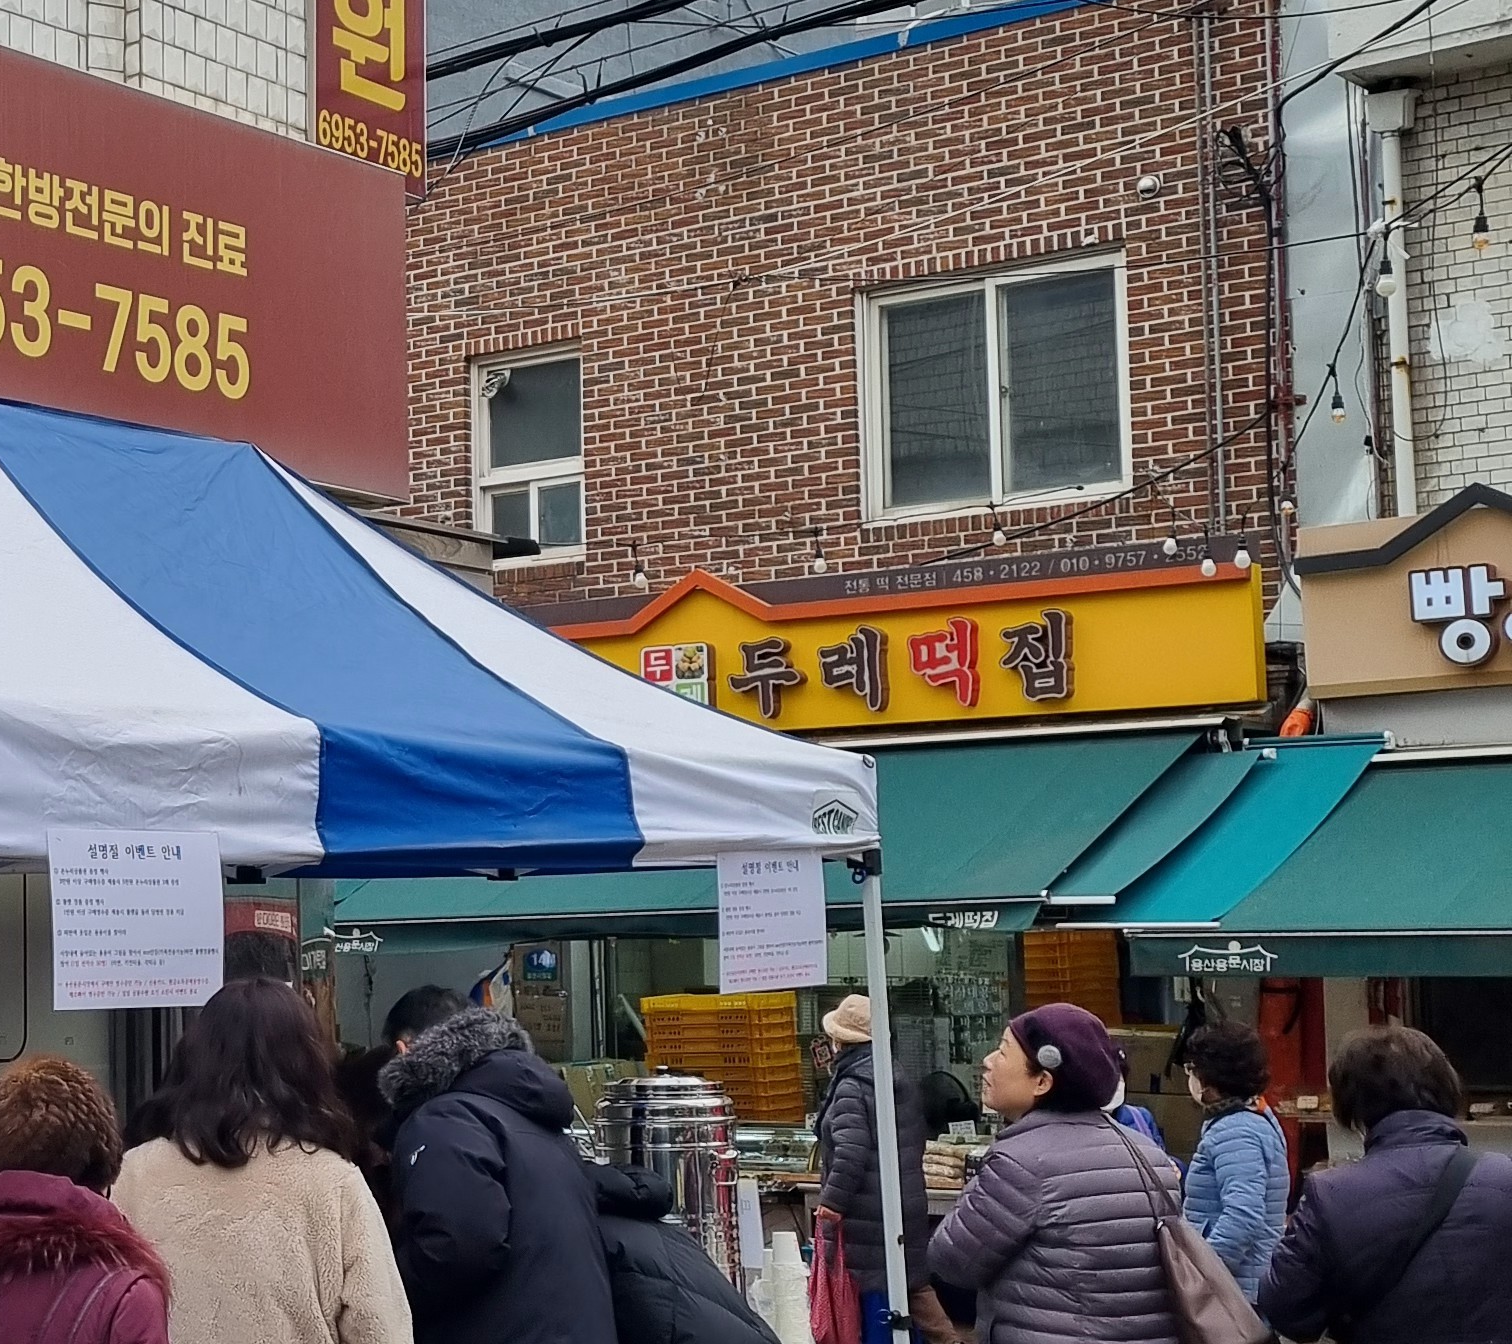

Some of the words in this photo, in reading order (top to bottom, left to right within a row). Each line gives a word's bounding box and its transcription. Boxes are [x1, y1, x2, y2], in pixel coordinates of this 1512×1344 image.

[318, 108, 422, 178] 6953-7585
[182, 209, 249, 277] 진료
[844, 577, 871, 595] 전통
[876, 576, 889, 591] 떡
[895, 572, 937, 588] 전문점
[1410, 565, 1512, 664] 빵
[87, 843, 119, 860] 설명절
[125, 844, 156, 860] 이벤트
[161, 844, 182, 860] 안내
[1190, 954, 1265, 973] 용산용문시장
